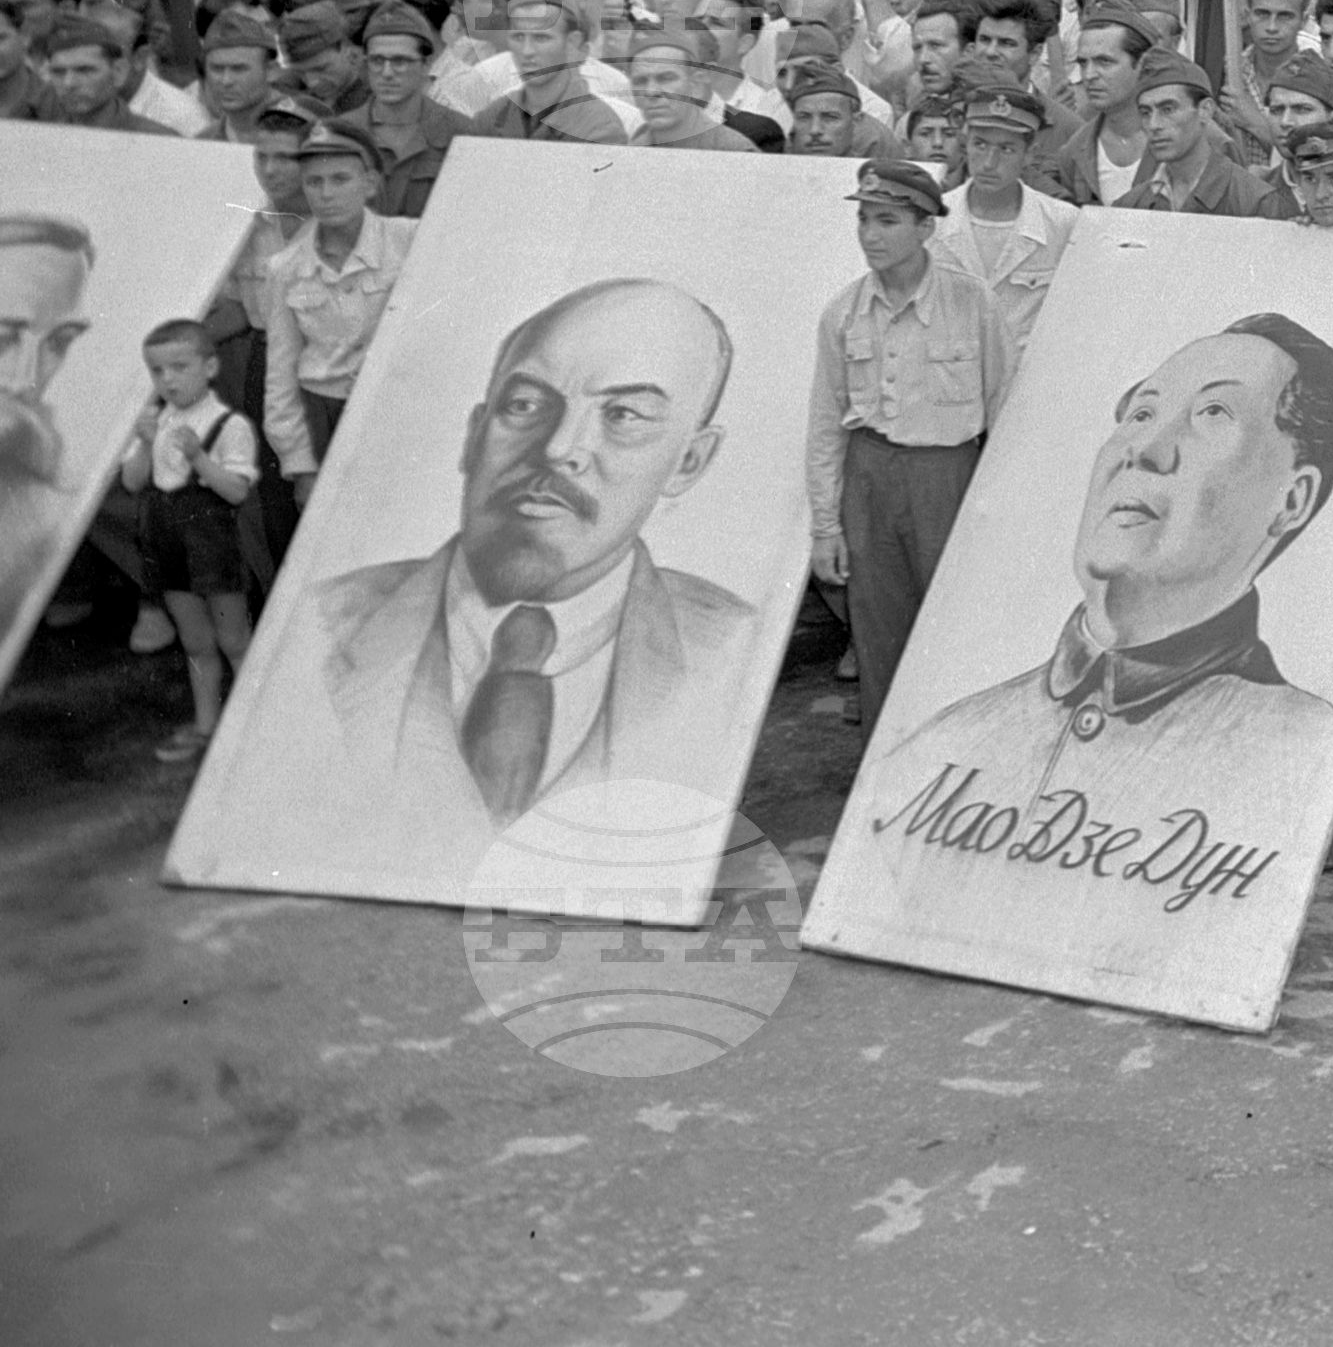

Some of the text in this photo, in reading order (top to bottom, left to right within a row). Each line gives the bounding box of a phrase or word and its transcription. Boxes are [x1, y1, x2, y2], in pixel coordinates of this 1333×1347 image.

[873, 762, 1280, 913] Мао Дзе Дун
